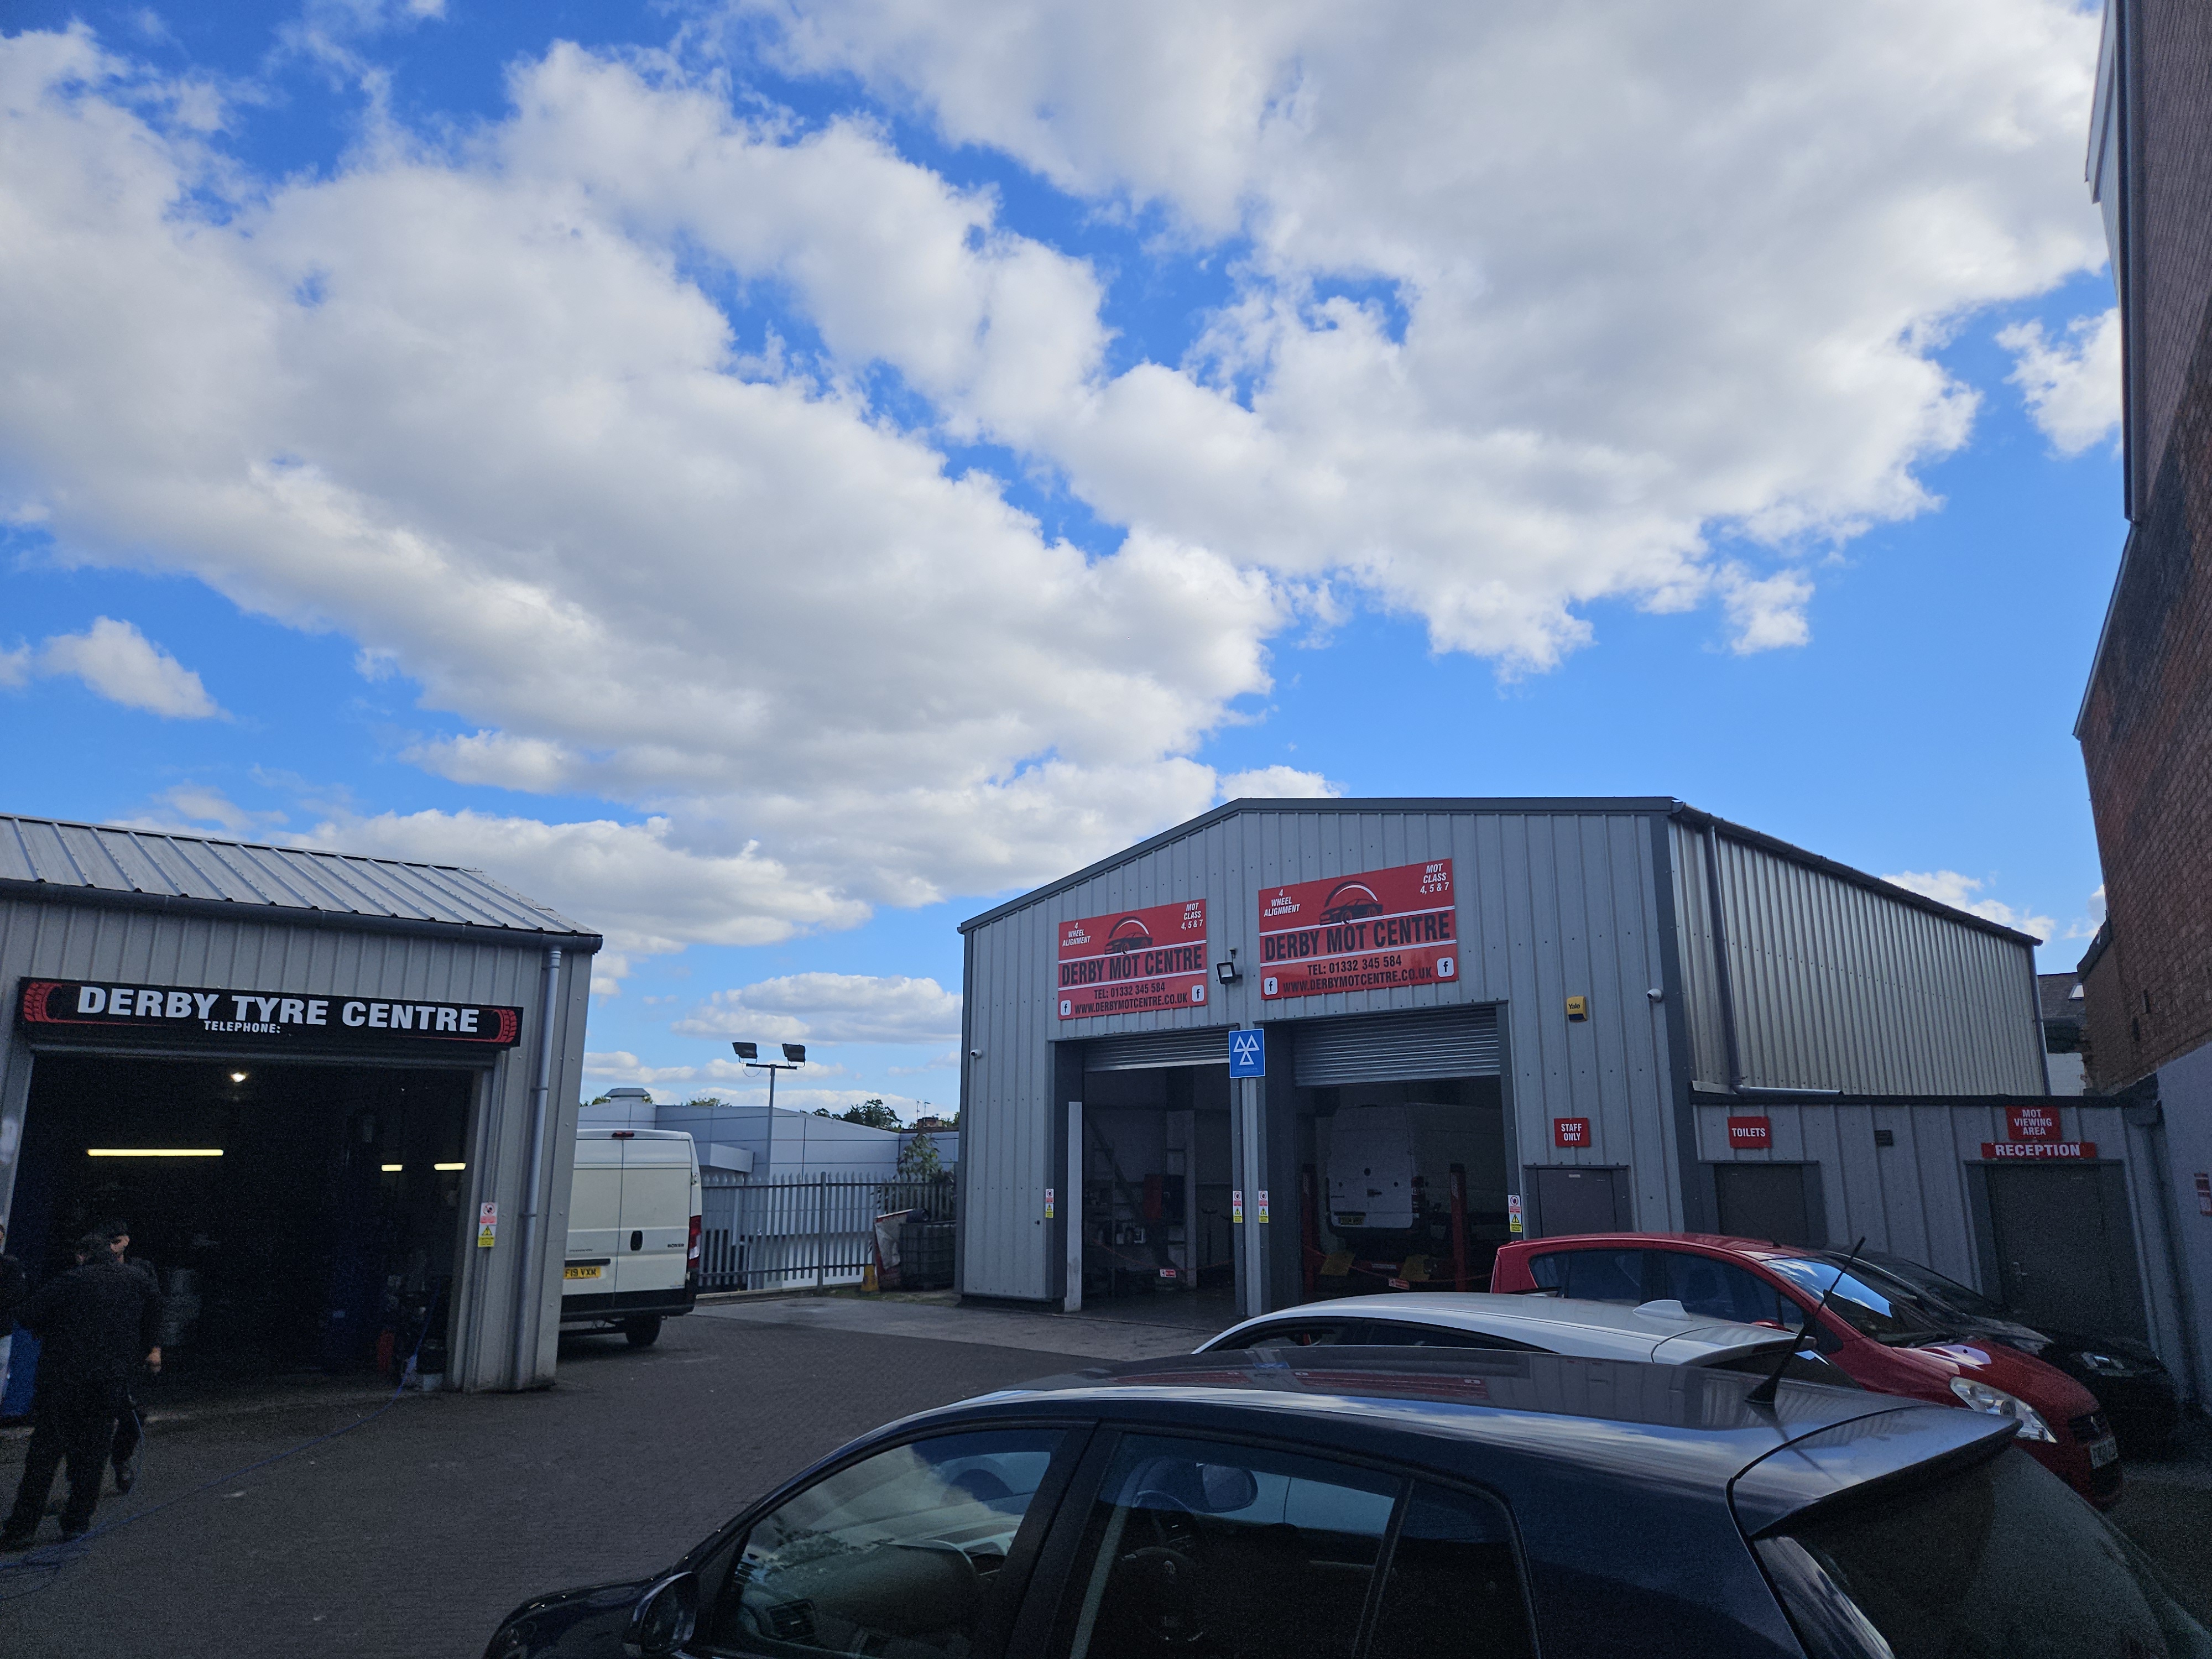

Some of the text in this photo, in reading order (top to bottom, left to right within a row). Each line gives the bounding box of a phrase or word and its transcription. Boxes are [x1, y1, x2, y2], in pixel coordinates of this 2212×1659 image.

[1426, 863, 1443, 874] MOT
[1423, 872, 1447, 884] CLASS
[1279, 889, 1284, 897] 4
[1420, 881, 1450, 895] 4, 5 & 7
[1186, 902, 1199, 911] MOT
[1271, 896, 1292, 907] WHEEL
[1183, 911, 1201, 920] CLASS
[1263, 904, 1301, 917] ALIGNMENT
[1181, 922, 1187, 930] 4,
[1188, 921, 1192, 929] 5
[1068, 929, 1085, 938] WHEEL
[1265, 913, 1450, 961] DERBY MOT CENTRE
[1062, 936, 1091, 947] ALIGNMENT
[1062, 946, 1202, 986] DERBY MOT CENTRE
[1307, 954, 1402, 976] TEL: 01332 345 584
[1282, 967, 1432, 993] WWW.DERBYMOTCENTRE.CO.UK
[1094, 982, 1165, 1000] TEL: 01332 345 584
[77, 986, 479, 1032] DERBY TYRE CENTRE
[1074, 993, 1187, 1014] WWW.DERBYMOTCENTRE.CO.UK
[204, 1020, 281, 1034] TELEPHONE:
[2022, 1109, 2042, 1118] MOT
[1561, 1123, 1582, 1133] STAFF
[2013, 1118, 2052, 1127] VIEWING
[1731, 1128, 1766, 1138] TOILETS
[2023, 1127, 2046, 1135] AREA
[1563, 1133, 1581, 1142] ONLY
[1995, 1144, 2080, 1156] RECEPTION
